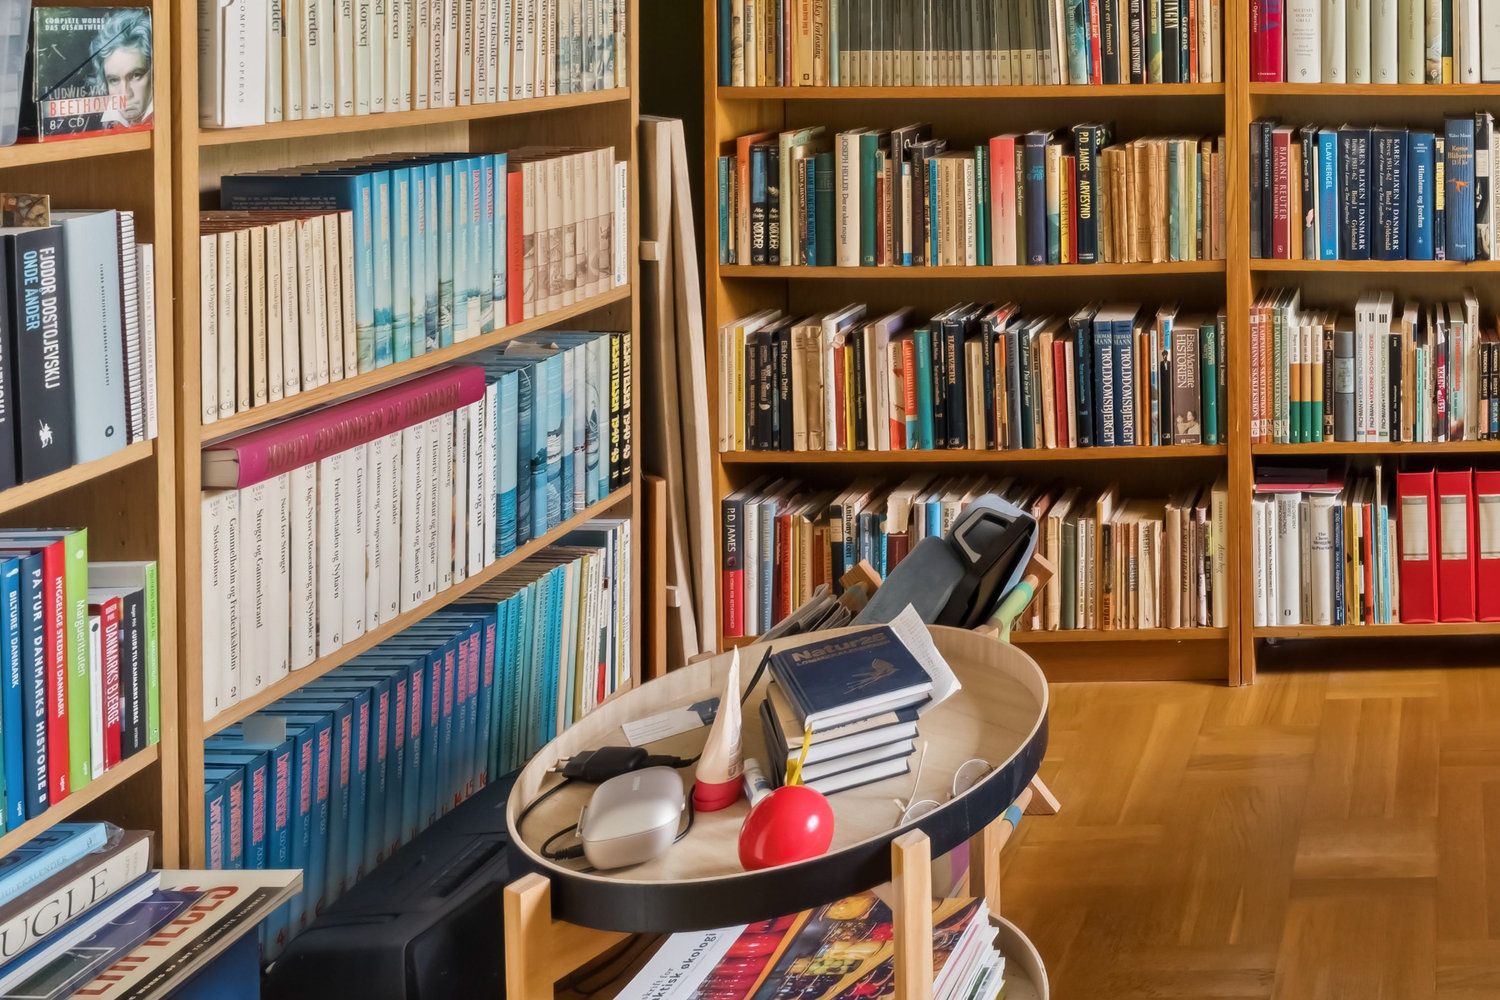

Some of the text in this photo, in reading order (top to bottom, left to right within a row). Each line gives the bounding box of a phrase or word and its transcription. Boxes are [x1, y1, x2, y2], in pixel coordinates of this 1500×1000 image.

[1105, 12, 1112, 22] en
[1106, 23, 1114, 55] fremmed
[49, 95, 127, 117] BEETHOVEN
[1079, 131, 1090, 219] P.D. JAMES ARVESYND
[1324, 142, 1333, 190] OLAV HERGEL
[1358, 138, 1366, 166] KAREN
[1279, 146, 1288, 221] BJARNE REUTER
[1358, 169, 1366, 200] BLIXEN
[1392, 169, 1400, 200] BLIXEN
[1358, 208, 1366, 250] DANMARK
[23, 251, 43, 331] ONDE ÅNDER
[40, 247, 61, 389] FJODOR DOSTOJEVSKIJ
[780, 340, 788, 353] Elia
[1176, 333, 1187, 389] HISTORIEN
[1186, 333, 1196, 389] Elsa Morante
[1101, 345, 1114, 444] TROLDDOMSBJERGET
[1120, 346, 1134, 444] TROLDDOMSBJERGET
[726, 507, 736, 553] P.D. JAMES
[31, 568, 43, 587] PÅ
[212, 524, 220, 586] Slotsholmen
[8, 590, 19, 630] BILTURE
[32, 591, 42, 622] TUR
[55, 576, 63, 628] HYGGELIGE
[227, 517, 238, 671] Gammelholm og Frederiksholm
[10, 639, 20, 688] DANMARK
[56, 628, 64, 659] STEDER
[33, 639, 45, 718] DANMARKS
[56, 668, 65, 718] DANMARK
[104, 624, 119, 728] DANMARKS BJERGE
[36, 721, 47, 790] HISTORIE
